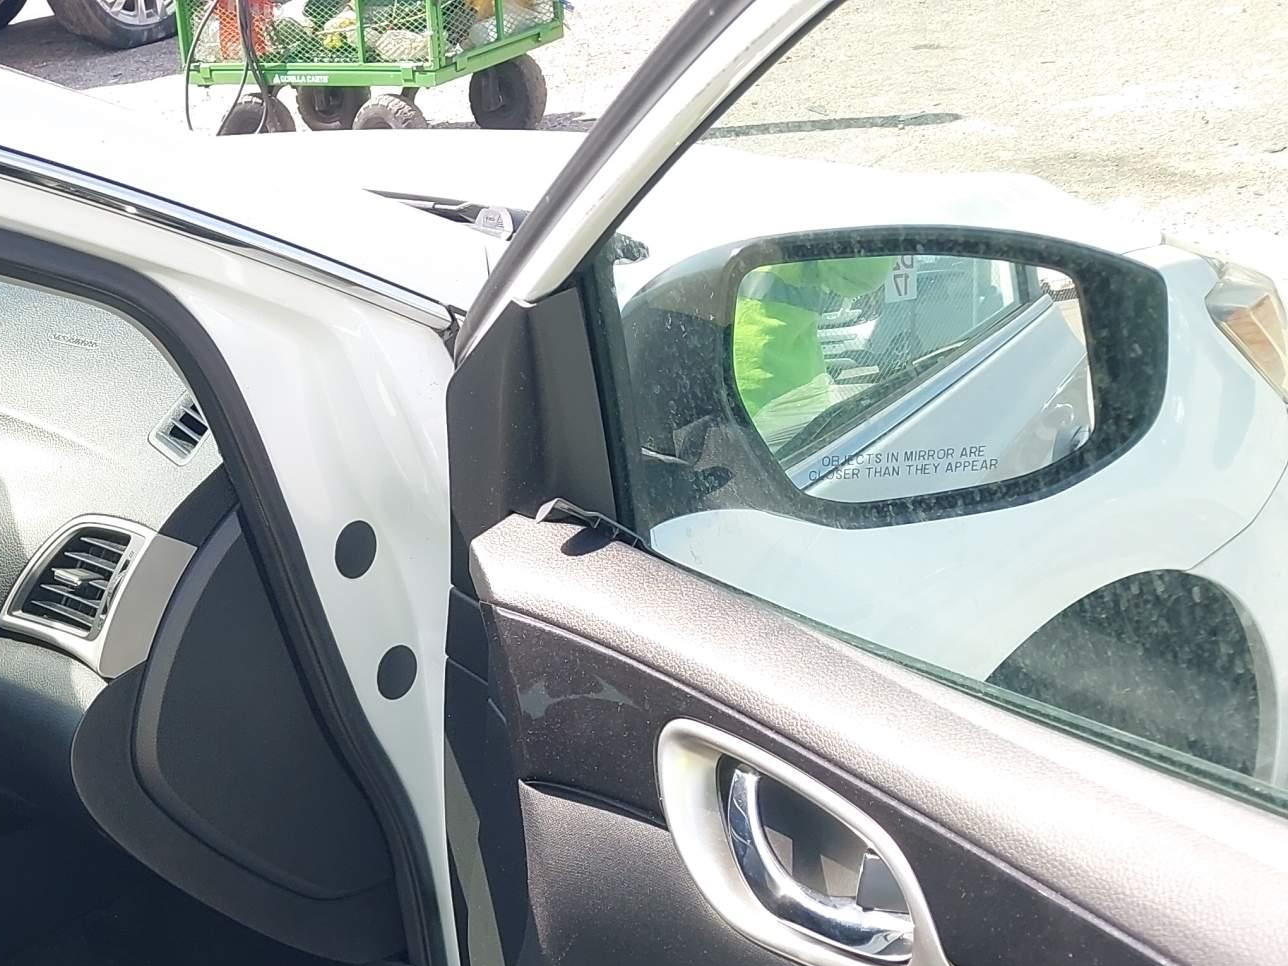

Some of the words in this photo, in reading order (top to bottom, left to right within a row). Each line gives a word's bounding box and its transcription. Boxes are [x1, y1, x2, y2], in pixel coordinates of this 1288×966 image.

[821, 453, 883, 467] OBJECTS
[886, 451, 899, 463] IN
[904, 448, 955, 461] MIRROR
[959, 445, 987, 458] ARE
[808, 468, 861, 481] CLOSER
[865, 466, 900, 479] THAN
[905, 463, 941, 476] THEY
[945, 458, 999, 473] APPEAR
